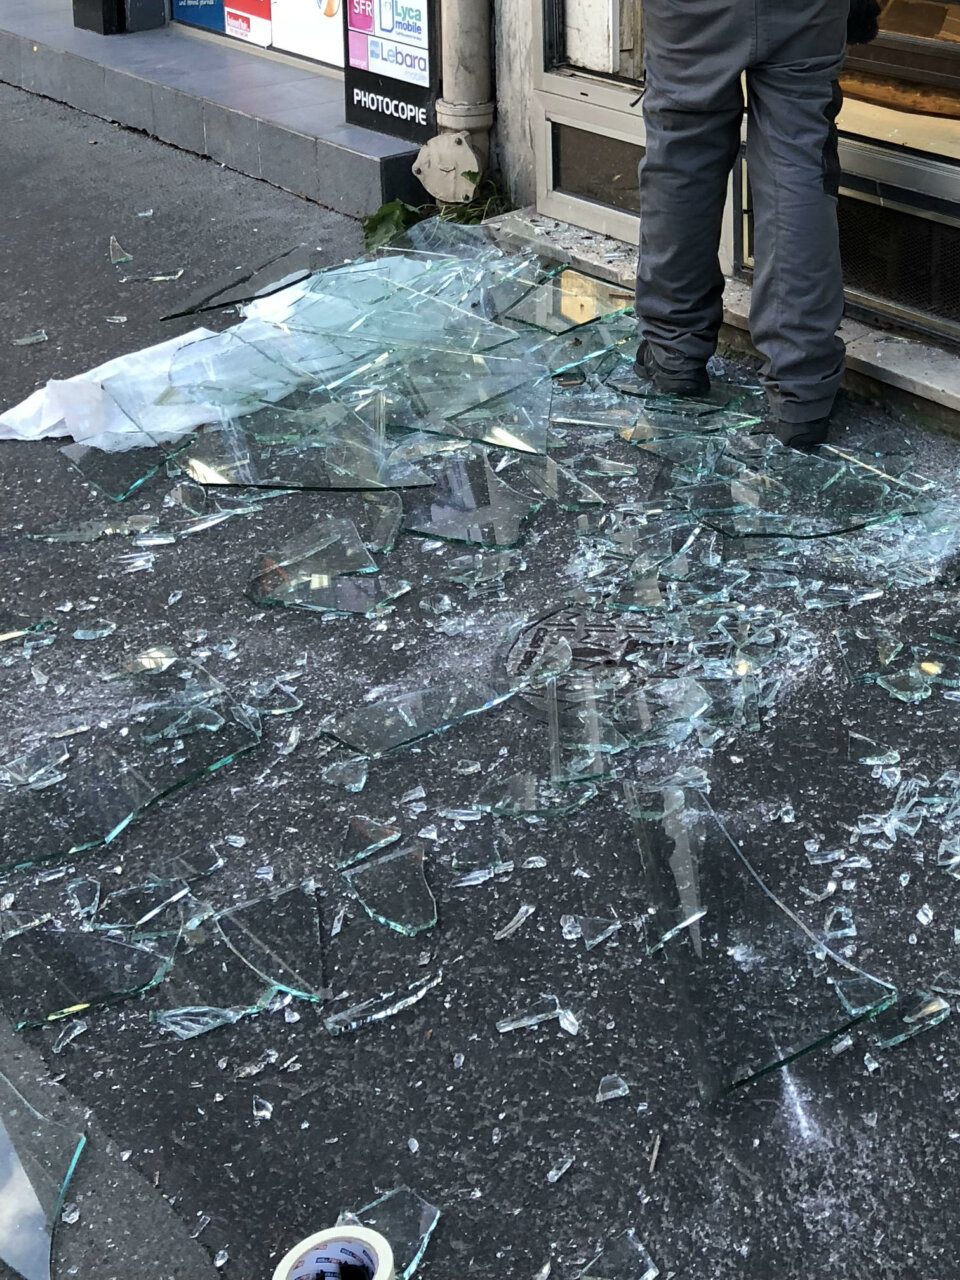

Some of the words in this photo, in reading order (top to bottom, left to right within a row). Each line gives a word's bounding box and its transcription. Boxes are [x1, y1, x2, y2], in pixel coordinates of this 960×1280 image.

[394, 0, 422, 22] Lyca
[395, 20, 422, 35] mobile
[380, 42, 427, 72] Lebara
[353, 88, 427, 125] PHOTOCOPIE
